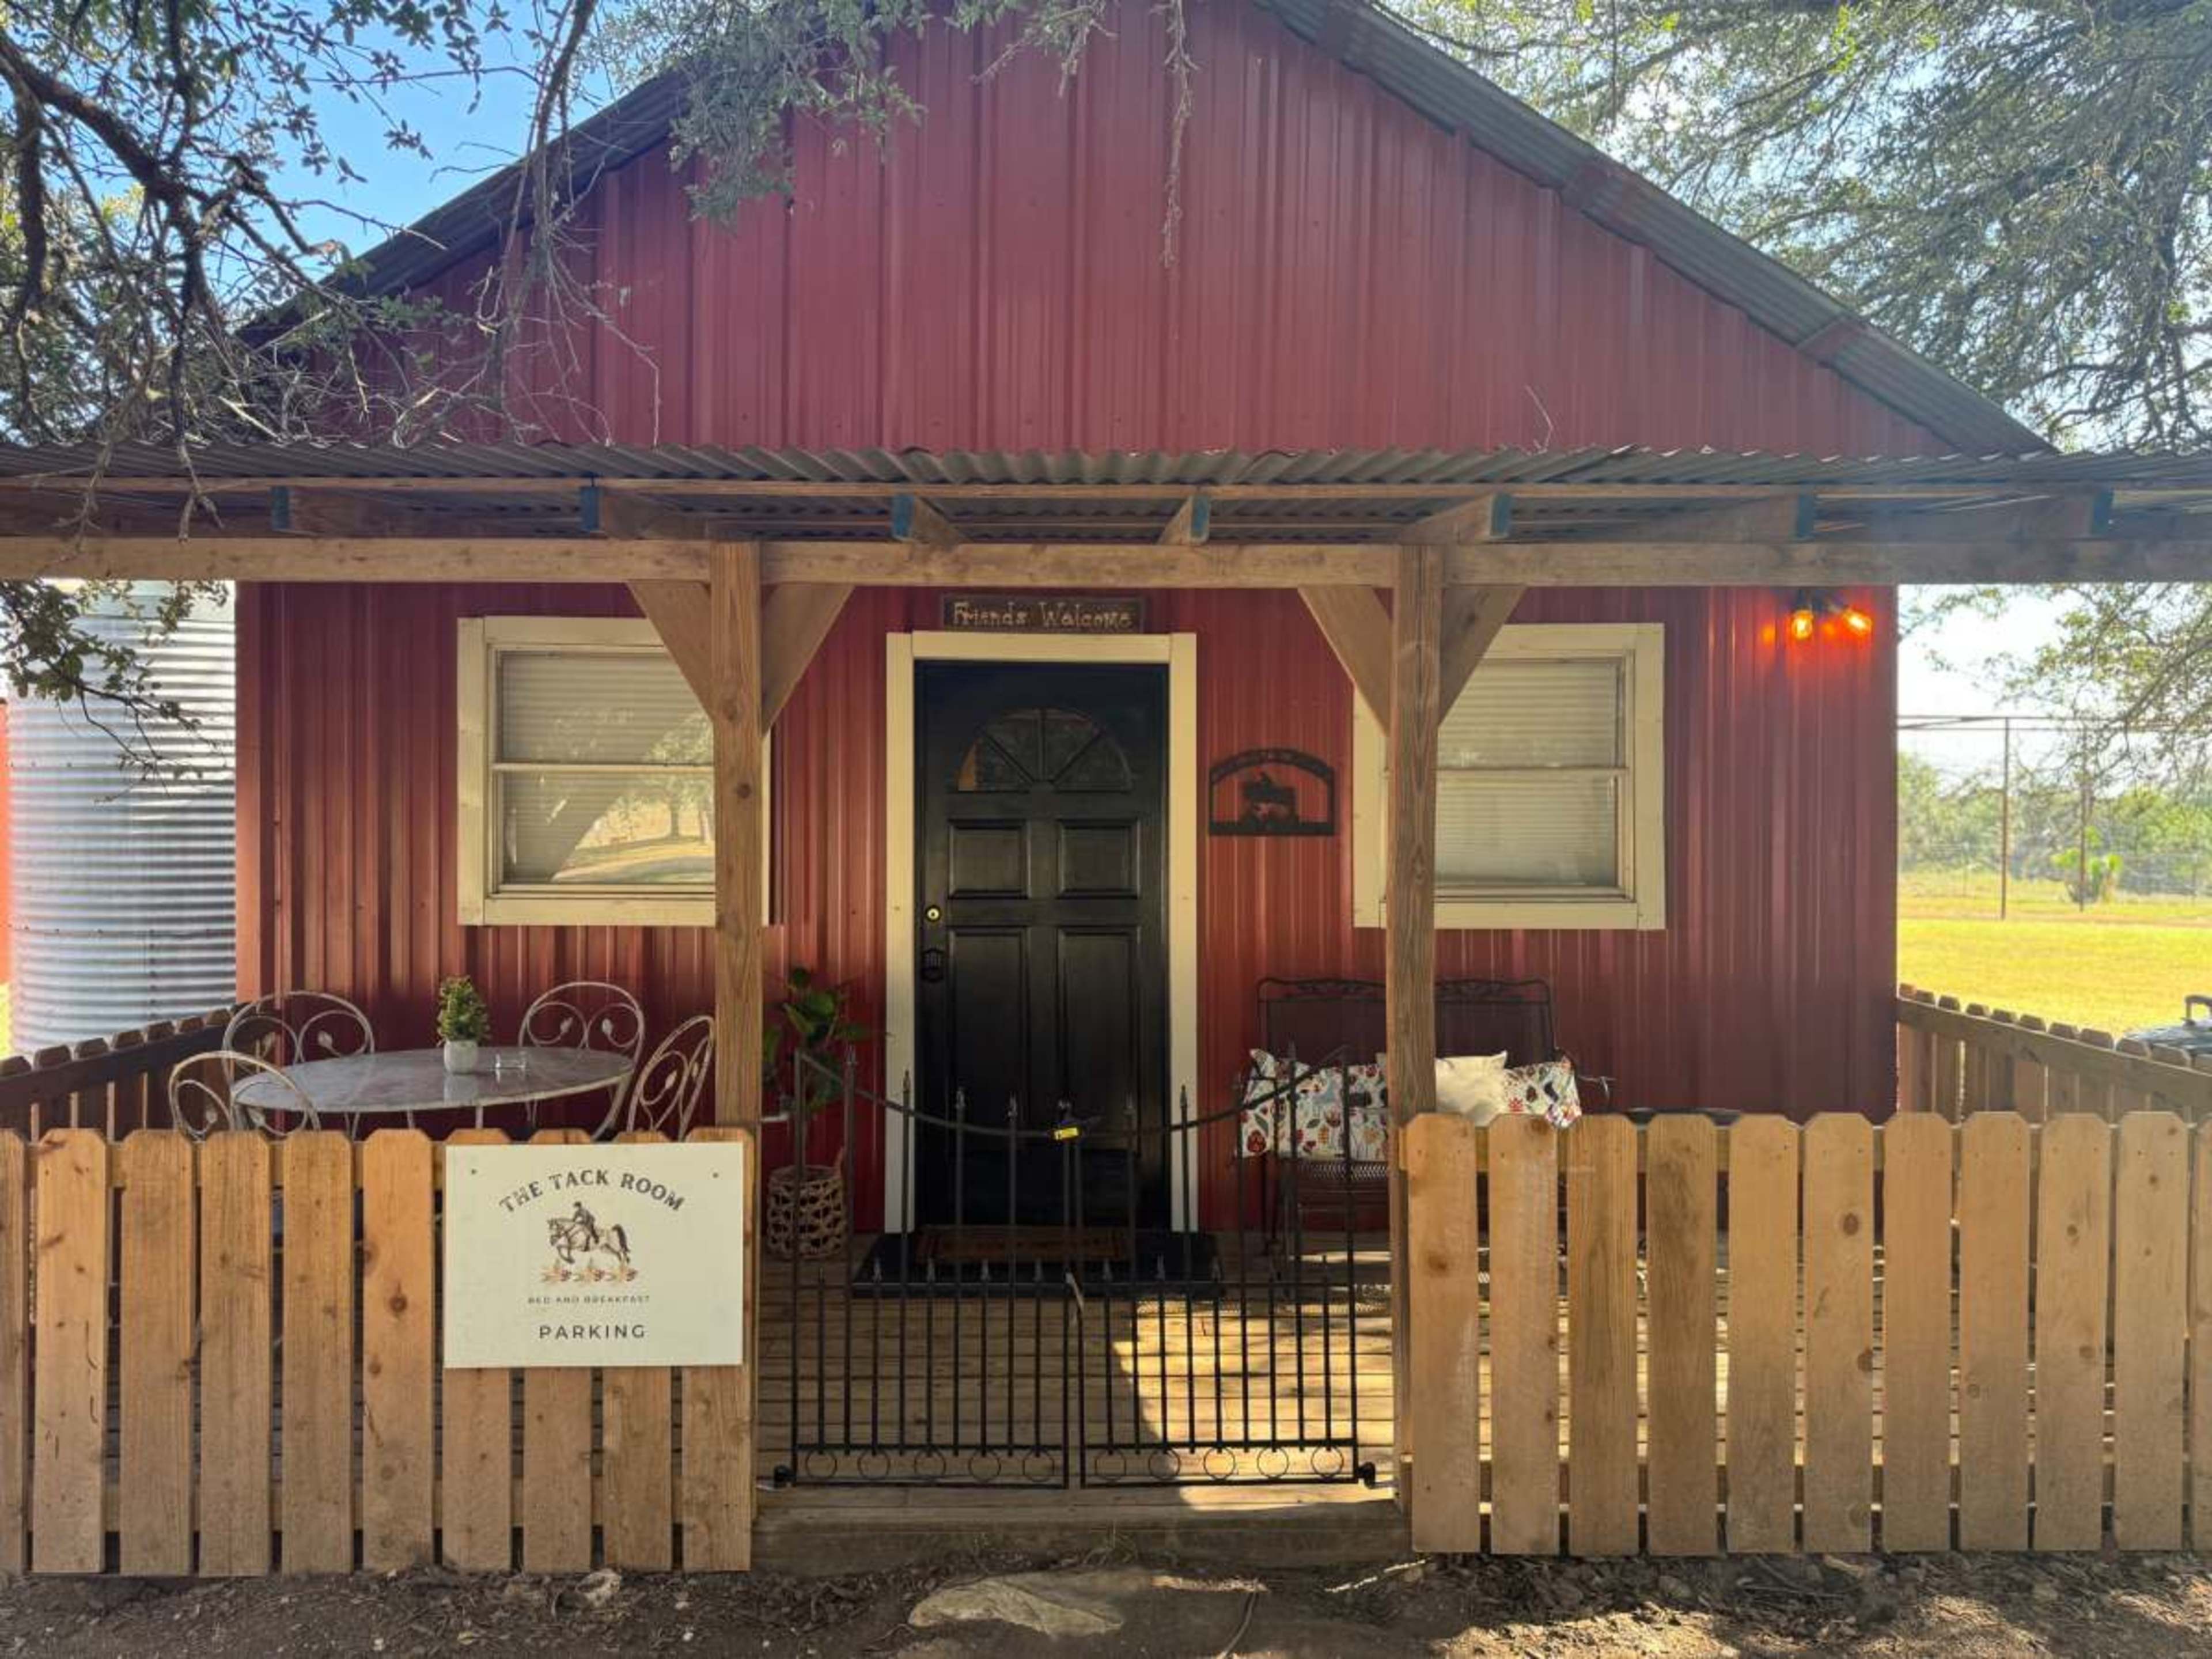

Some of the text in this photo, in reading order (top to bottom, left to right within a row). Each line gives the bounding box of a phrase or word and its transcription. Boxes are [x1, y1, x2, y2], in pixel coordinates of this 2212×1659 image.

[953, 601, 1028, 626] Friends
[499, 1169, 685, 1213] THE TACK ROOM
[556, 1296, 579, 1304] AND
[584, 1295, 650, 1304] BREAKFAST
[539, 1324, 646, 1339] PARKING
